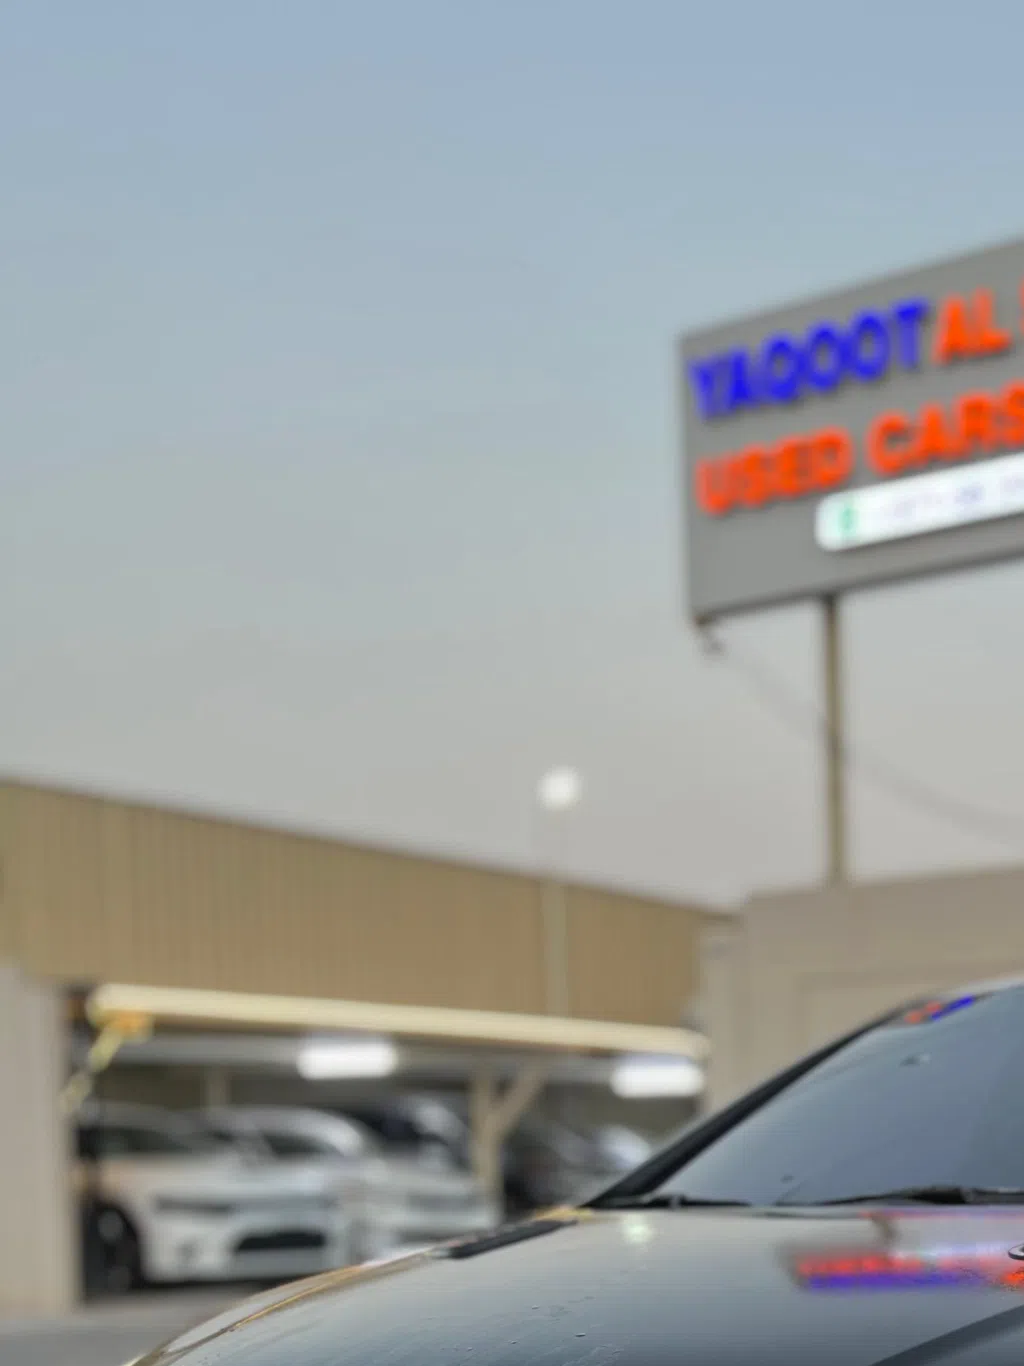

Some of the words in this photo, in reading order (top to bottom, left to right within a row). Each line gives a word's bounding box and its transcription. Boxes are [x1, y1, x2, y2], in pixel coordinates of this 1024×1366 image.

[689, 298, 928, 414] YAQOOT
[934, 292, 1011, 361] AL
[696, 427, 853, 513] USED
